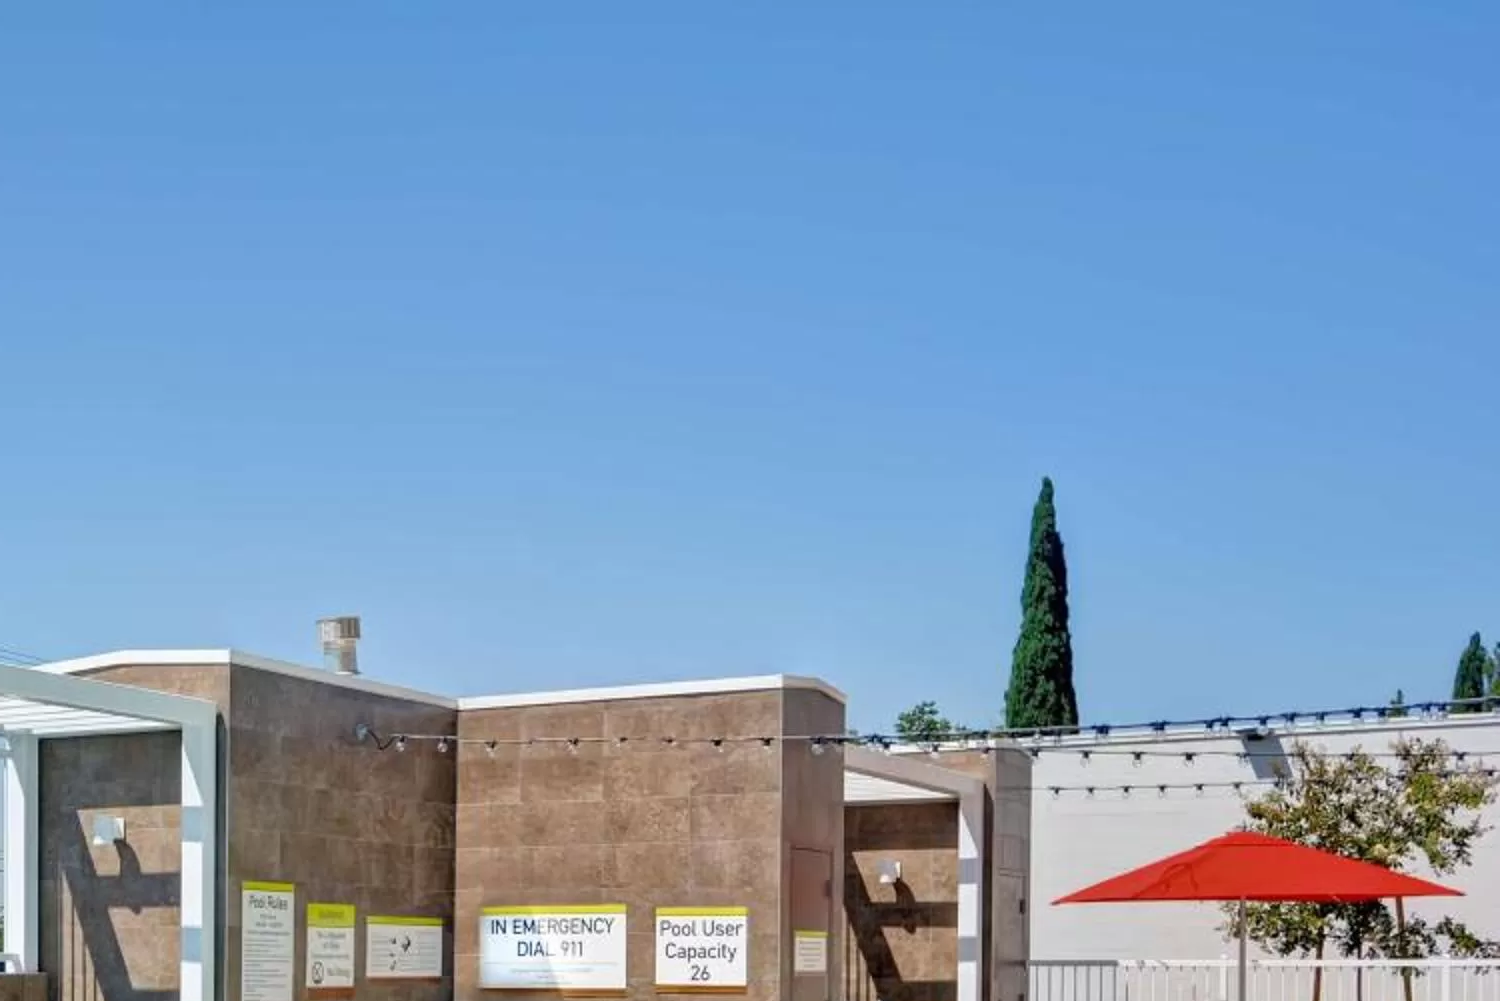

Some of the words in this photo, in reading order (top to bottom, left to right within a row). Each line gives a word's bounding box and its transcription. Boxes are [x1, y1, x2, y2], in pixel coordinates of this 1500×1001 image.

[491, 919, 507, 934] IN
[513, 918, 615, 934] EMERGENCY
[659, 920, 697, 936] Pool
[703, 920, 744, 936] User
[517, 941, 556, 956] DIAL
[561, 941, 584, 956] 911
[665, 942, 736, 964] Capacity
[691, 965, 711, 980] 26
